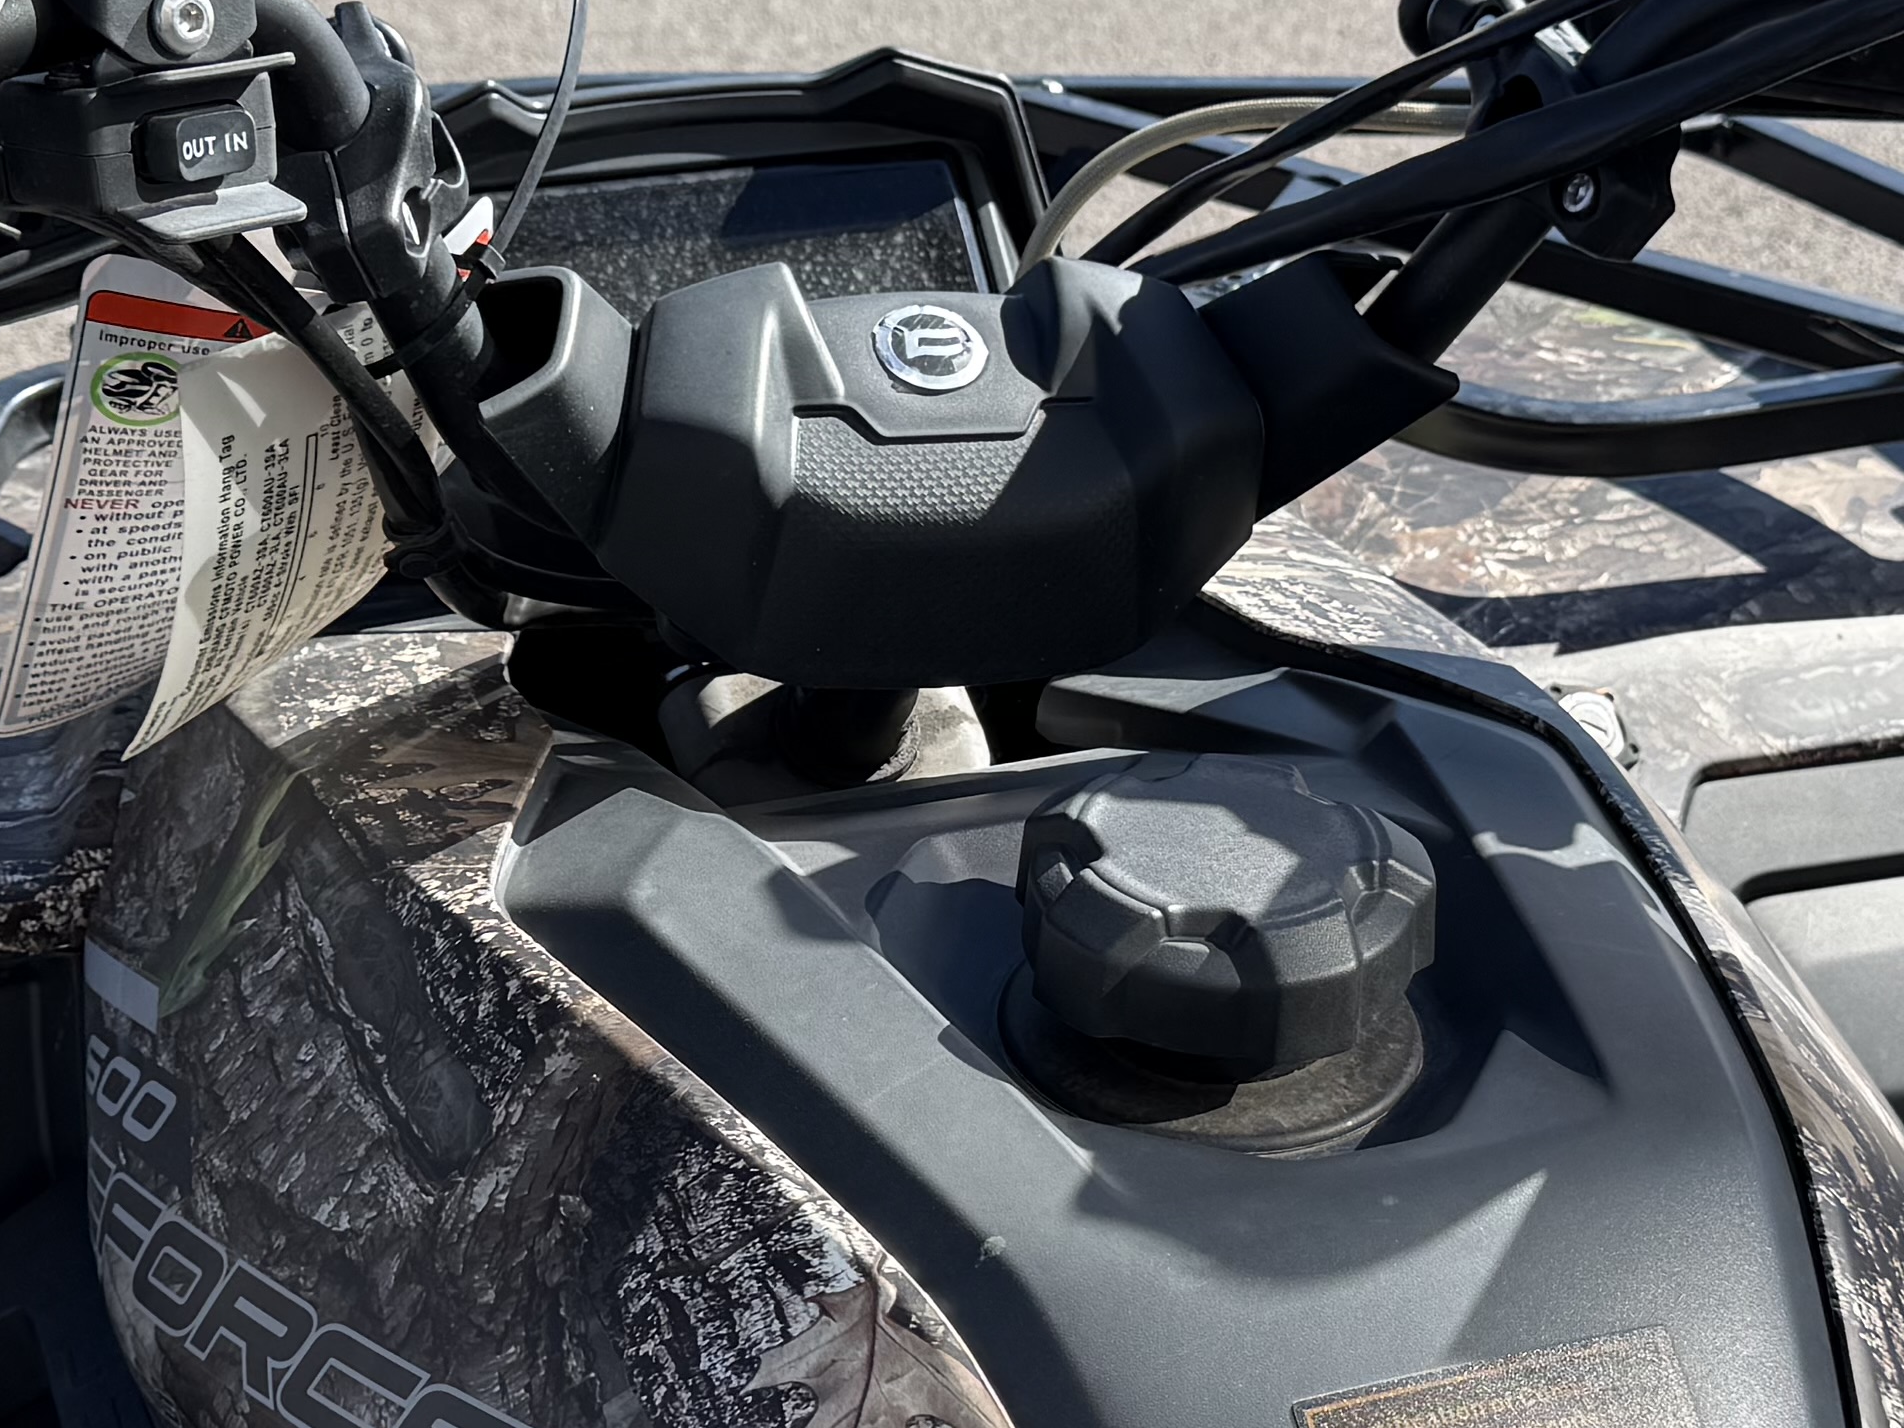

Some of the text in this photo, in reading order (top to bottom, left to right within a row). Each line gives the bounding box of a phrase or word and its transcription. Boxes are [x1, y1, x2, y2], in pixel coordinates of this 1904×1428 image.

[182, 131, 248, 162] OUT IN
[99, 330, 211, 356] Improper use
[88, 425, 182, 438] ALWAYS USE
[219, 434, 236, 463] Tag
[218, 465, 236, 504] Hang
[64, 498, 140, 510] NEVER
[90, 521, 182, 536] at speeds
[84, 545, 172, 560] on public
[211, 506, 231, 582] Information
[228, 521, 245, 569] POWER
